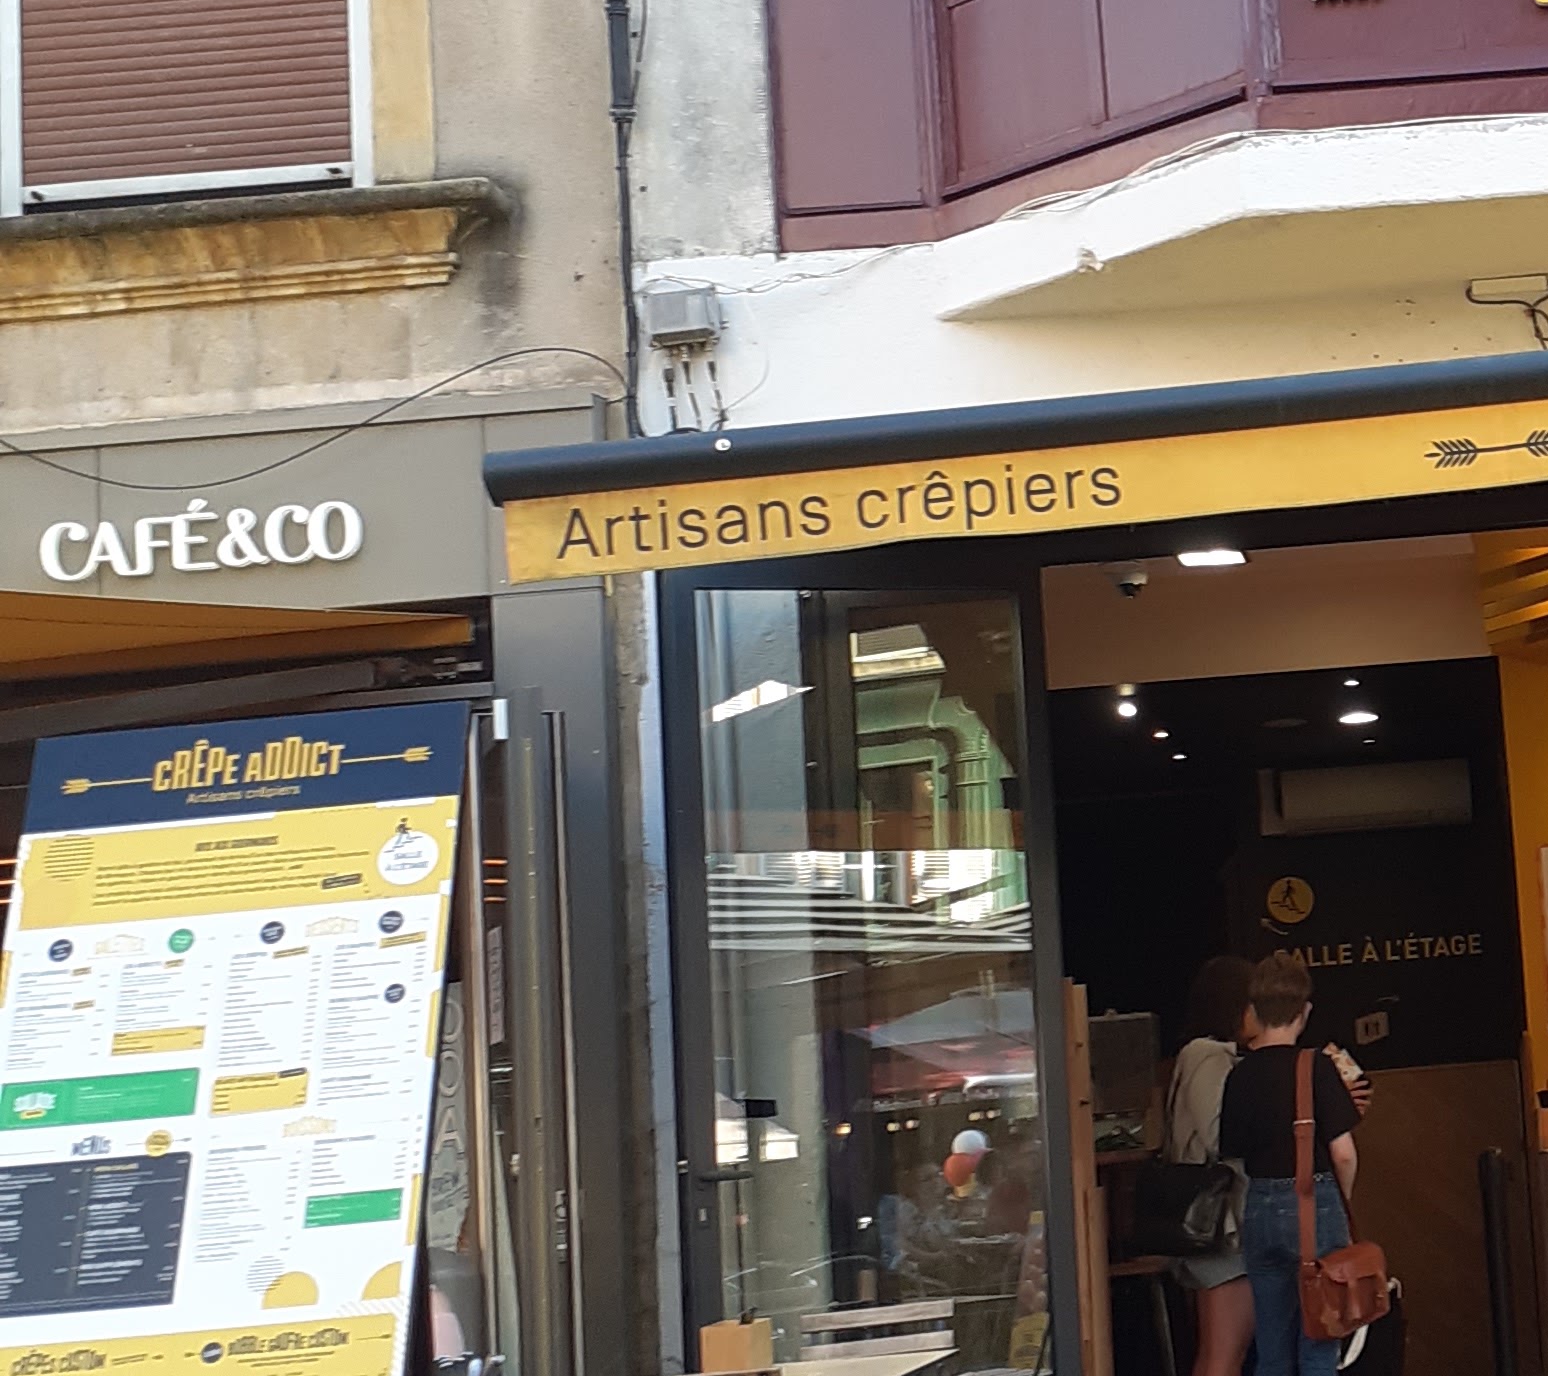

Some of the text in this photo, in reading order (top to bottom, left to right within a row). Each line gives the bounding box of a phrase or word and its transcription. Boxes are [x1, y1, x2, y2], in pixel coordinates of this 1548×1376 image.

[39, 498, 364, 582] CAFÉ&CO
[556, 464, 1122, 561] Artisans crêpiers
[152, 736, 345, 791] CRÊPE ADDICT
[1361, 936, 1380, 963] À
[1386, 932, 1483, 962] L'ÉTAGE
